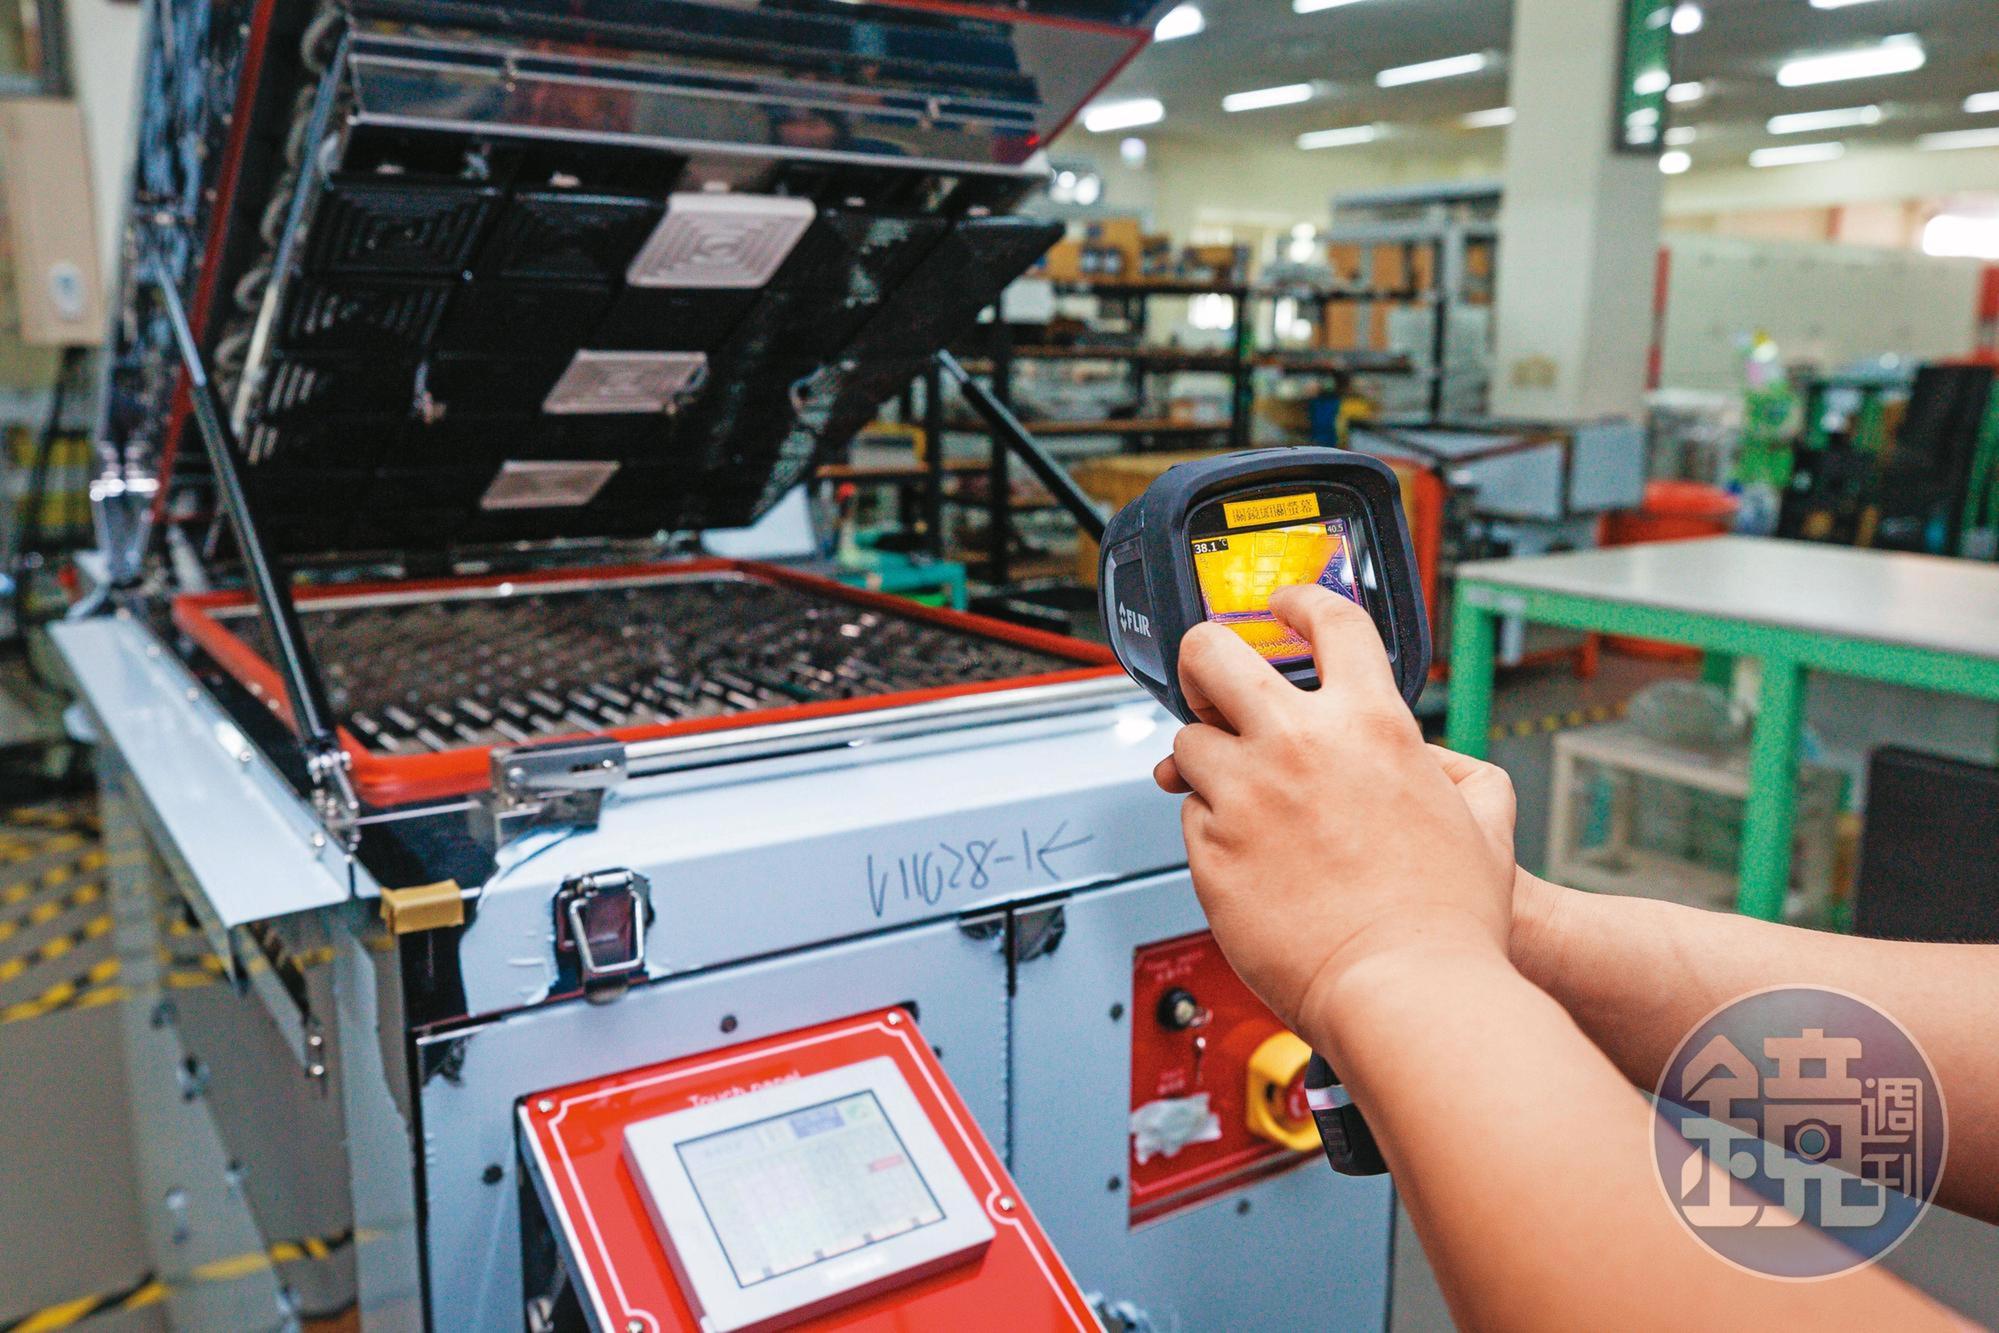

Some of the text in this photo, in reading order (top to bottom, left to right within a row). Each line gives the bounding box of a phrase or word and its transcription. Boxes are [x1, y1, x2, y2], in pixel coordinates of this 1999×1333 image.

[1327, 523, 1344, 533] 40.5
[1194, 542, 1217, 554] 38.1
[1126, 608, 1152, 638] FLIR
